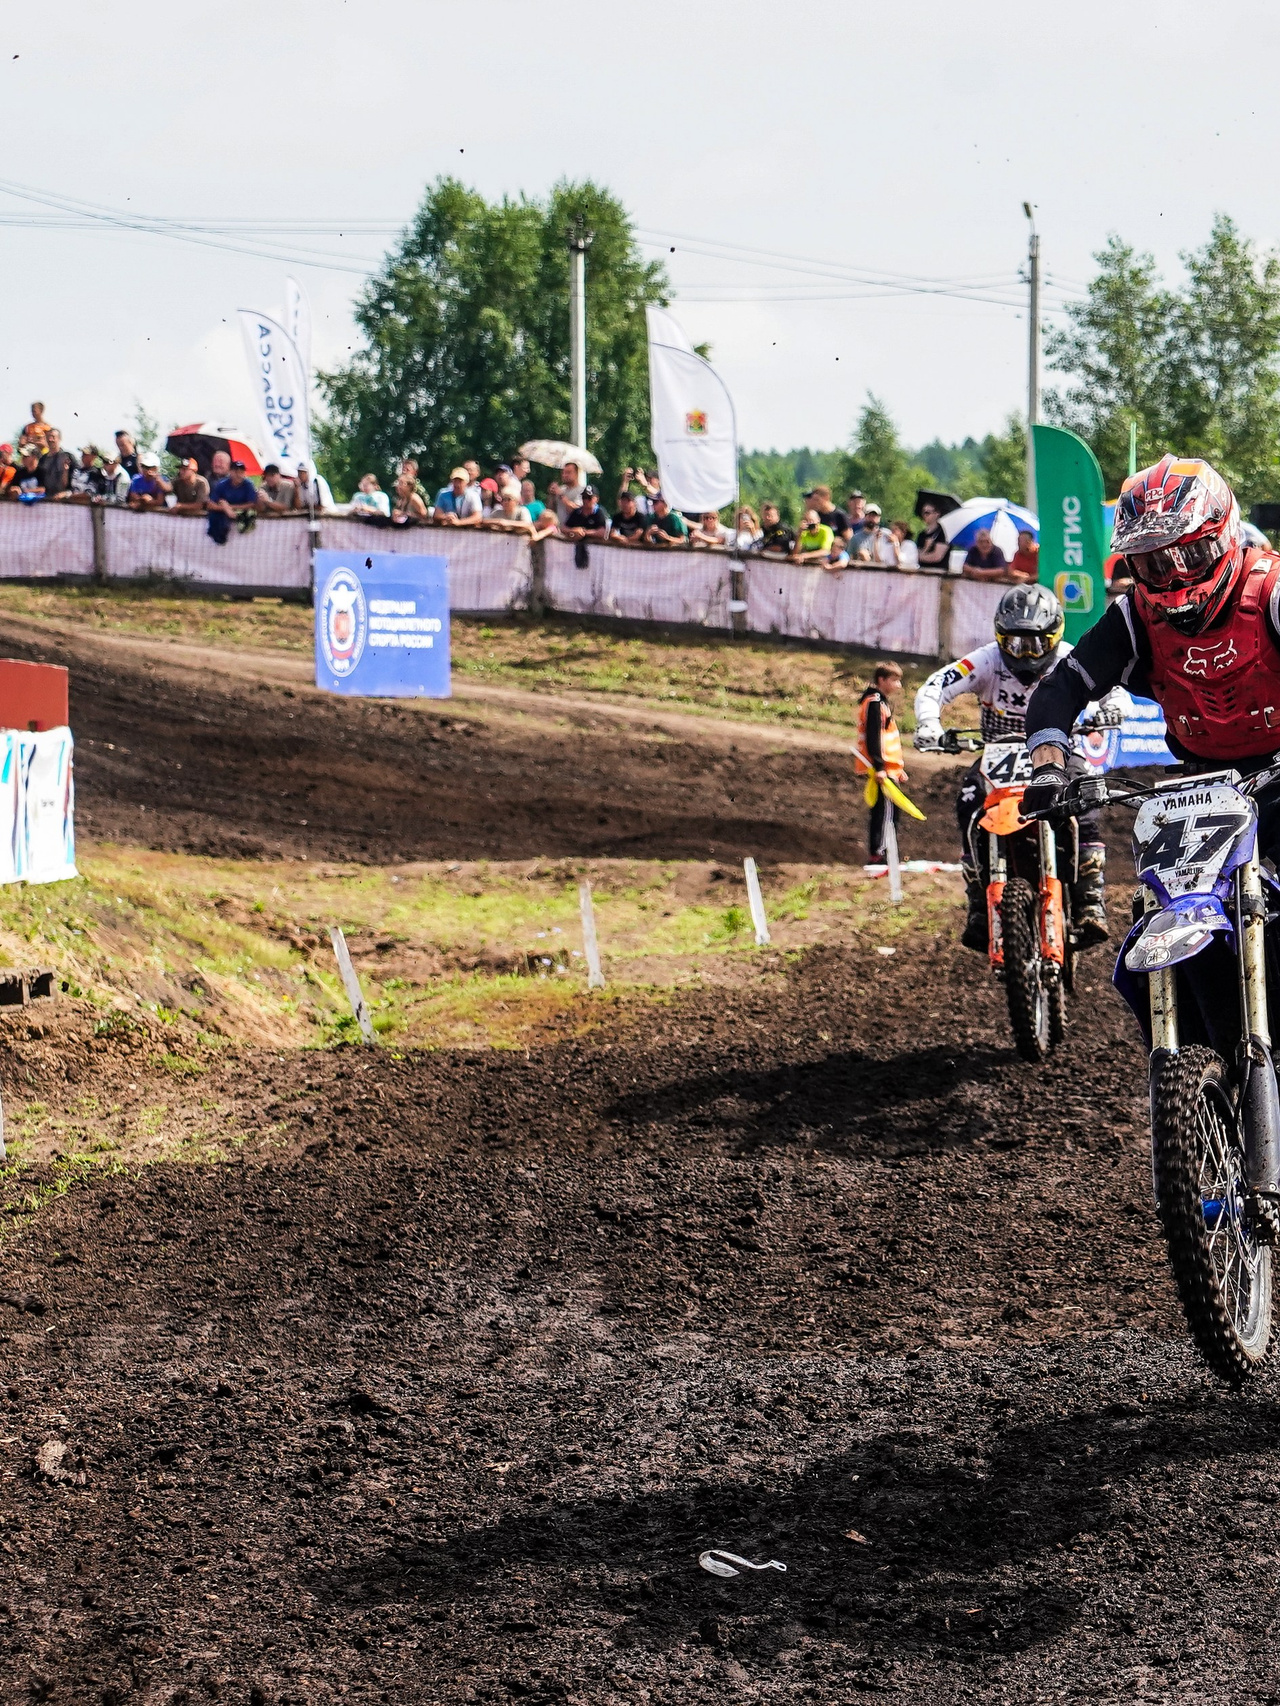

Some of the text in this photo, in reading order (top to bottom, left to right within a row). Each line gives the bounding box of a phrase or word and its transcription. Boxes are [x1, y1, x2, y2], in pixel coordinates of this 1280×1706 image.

[1062, 495, 1084, 567] 2ГИС
[1163, 791, 1212, 811] YAMAHA
[1139, 813, 1249, 873] 47
